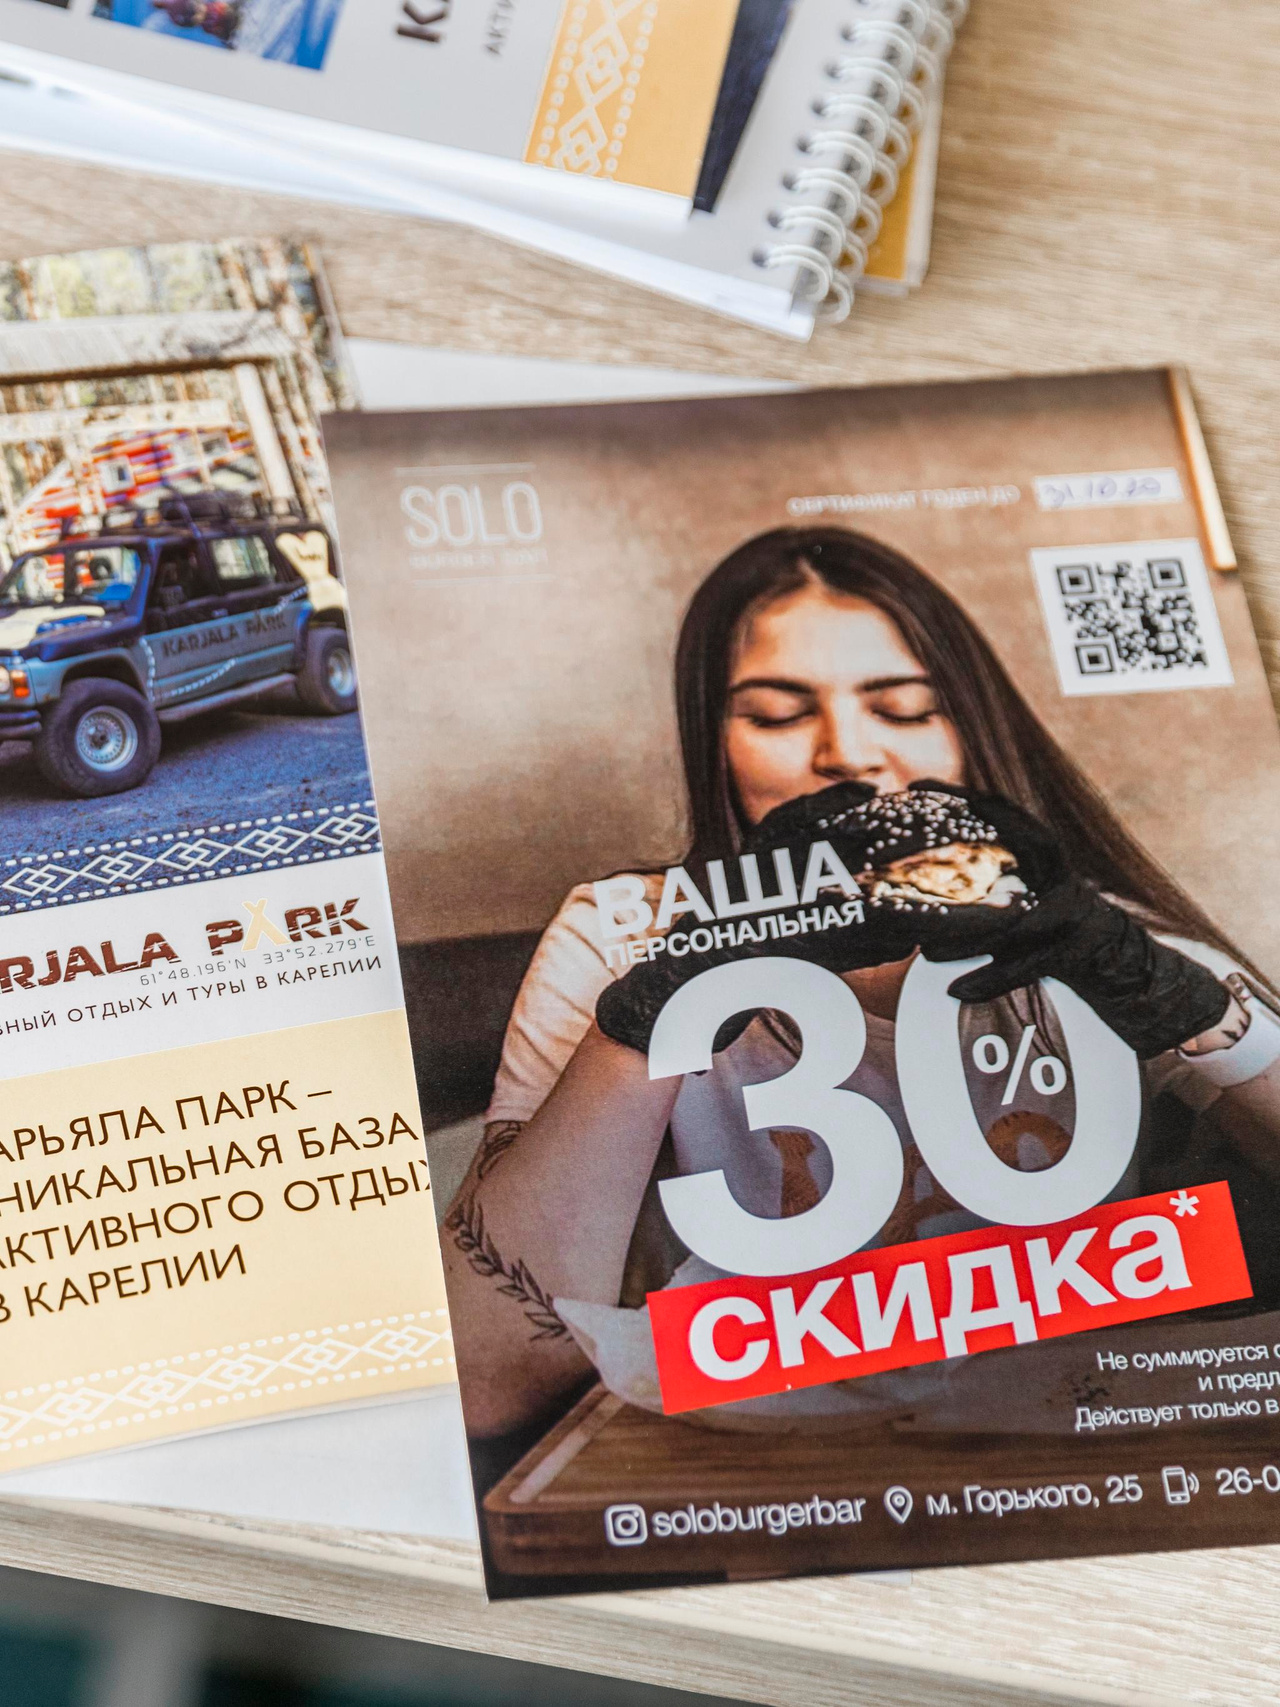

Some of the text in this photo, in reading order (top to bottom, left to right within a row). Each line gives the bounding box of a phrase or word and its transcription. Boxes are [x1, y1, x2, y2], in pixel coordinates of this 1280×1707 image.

[400, 481, 543, 547] SOLO
[163, 624, 240, 656] KARJALA
[593, 840, 863, 939] ВАША
[604, 900, 866, 969] ПЕРСОНАЛЬНАЯ
[67, 994, 153, 1023] ОТДЫХ
[161, 992, 178, 1006] И
[186, 981, 246, 1003] ТУРЫ
[257, 975, 269, 990] В
[277, 955, 382, 986] КАРЕЛИИ
[175, 1080, 298, 1130] ПАРК
[648, 954, 1142, 1277] 30
[297, 1111, 420, 1160] БАЗА
[24, 1244, 248, 1317] КАРЕЛИИ
[1096, 1351, 1128, 1372] Не
[1132, 1344, 1270, 1373] суммируется
[1197, 1375, 1213, 1392] и
[1074, 1397, 1280, 1433] Действует только в
[925, 1473, 1144, 1519] м. Горького, 25
[1215, 1465, 1280, 1497] 26-0
[651, 1495, 866, 1537] soloburgerbar
